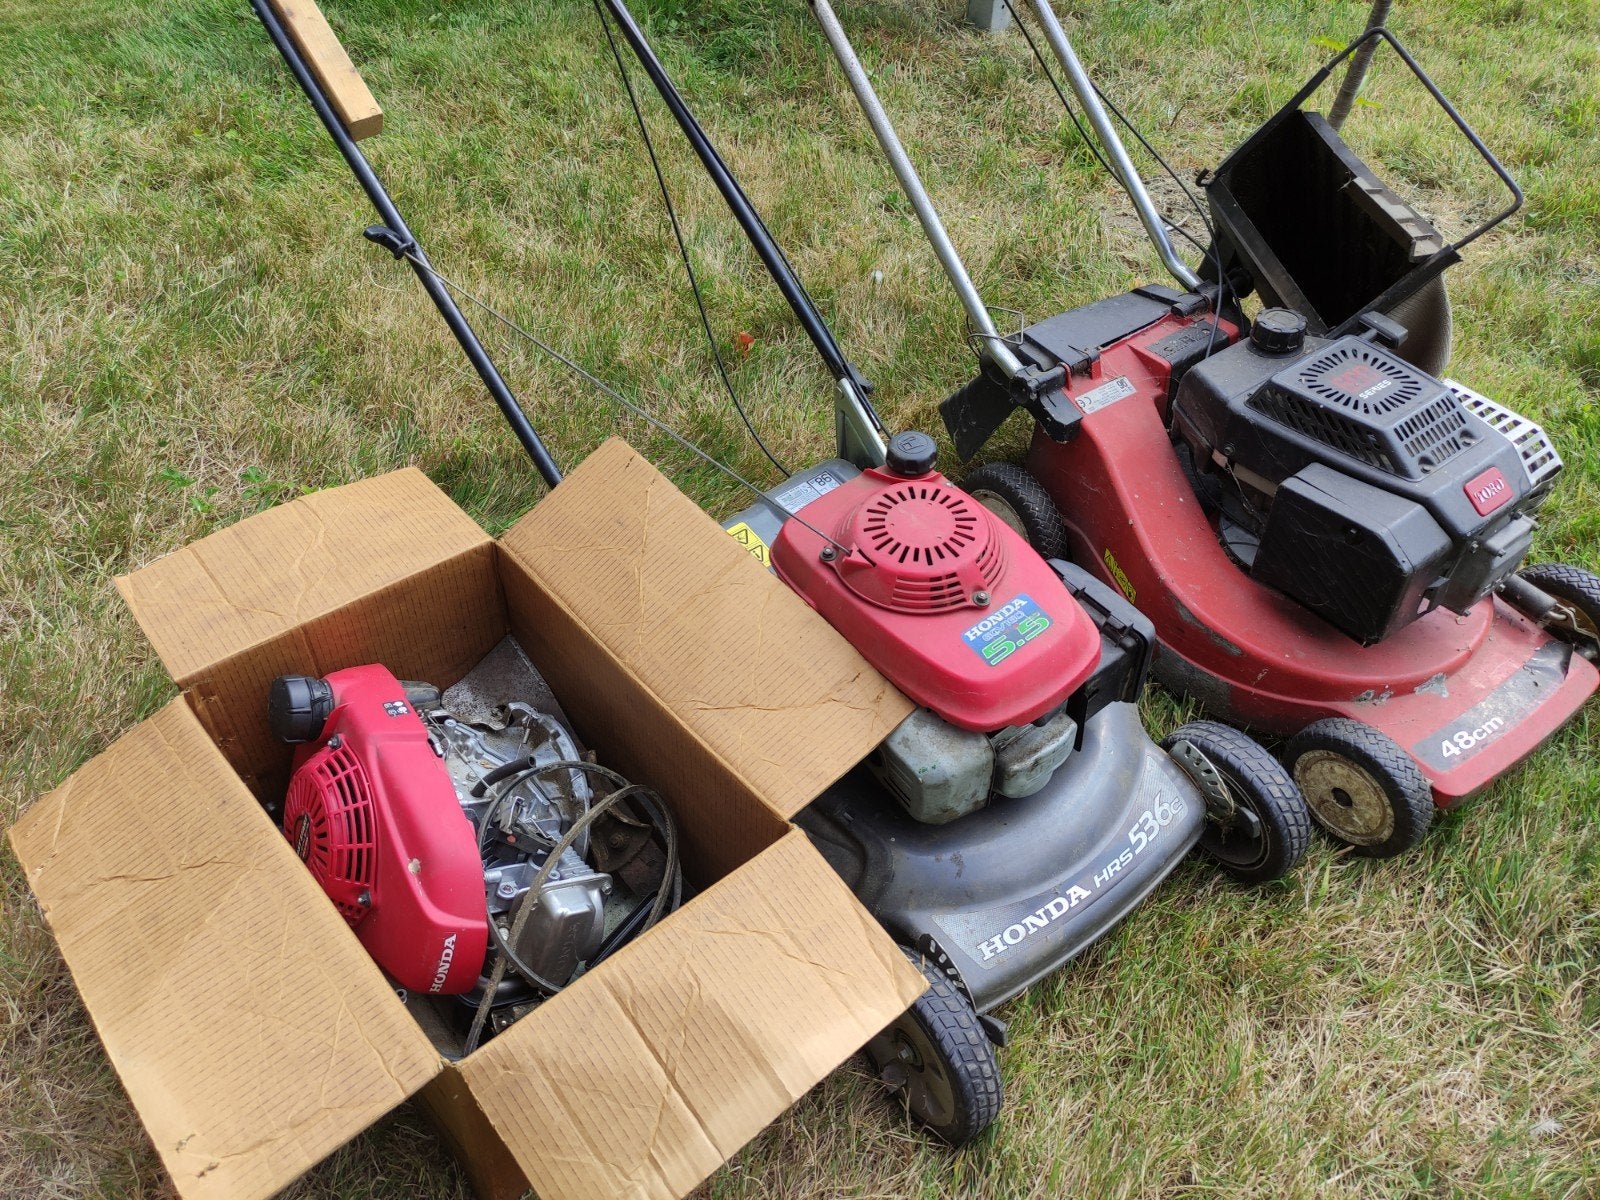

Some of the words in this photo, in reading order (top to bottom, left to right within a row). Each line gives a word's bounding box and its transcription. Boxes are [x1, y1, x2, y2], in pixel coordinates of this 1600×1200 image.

[1359, 379, 1392, 399] SERIES
[1473, 478, 1505, 503] TORO
[964, 598, 1028, 641] HONDA
[982, 612, 1050, 666] 5.5
[1441, 717, 1504, 758] 48cm
[976, 884, 1092, 962] HONDA
[429, 933, 457, 993] HONDA
